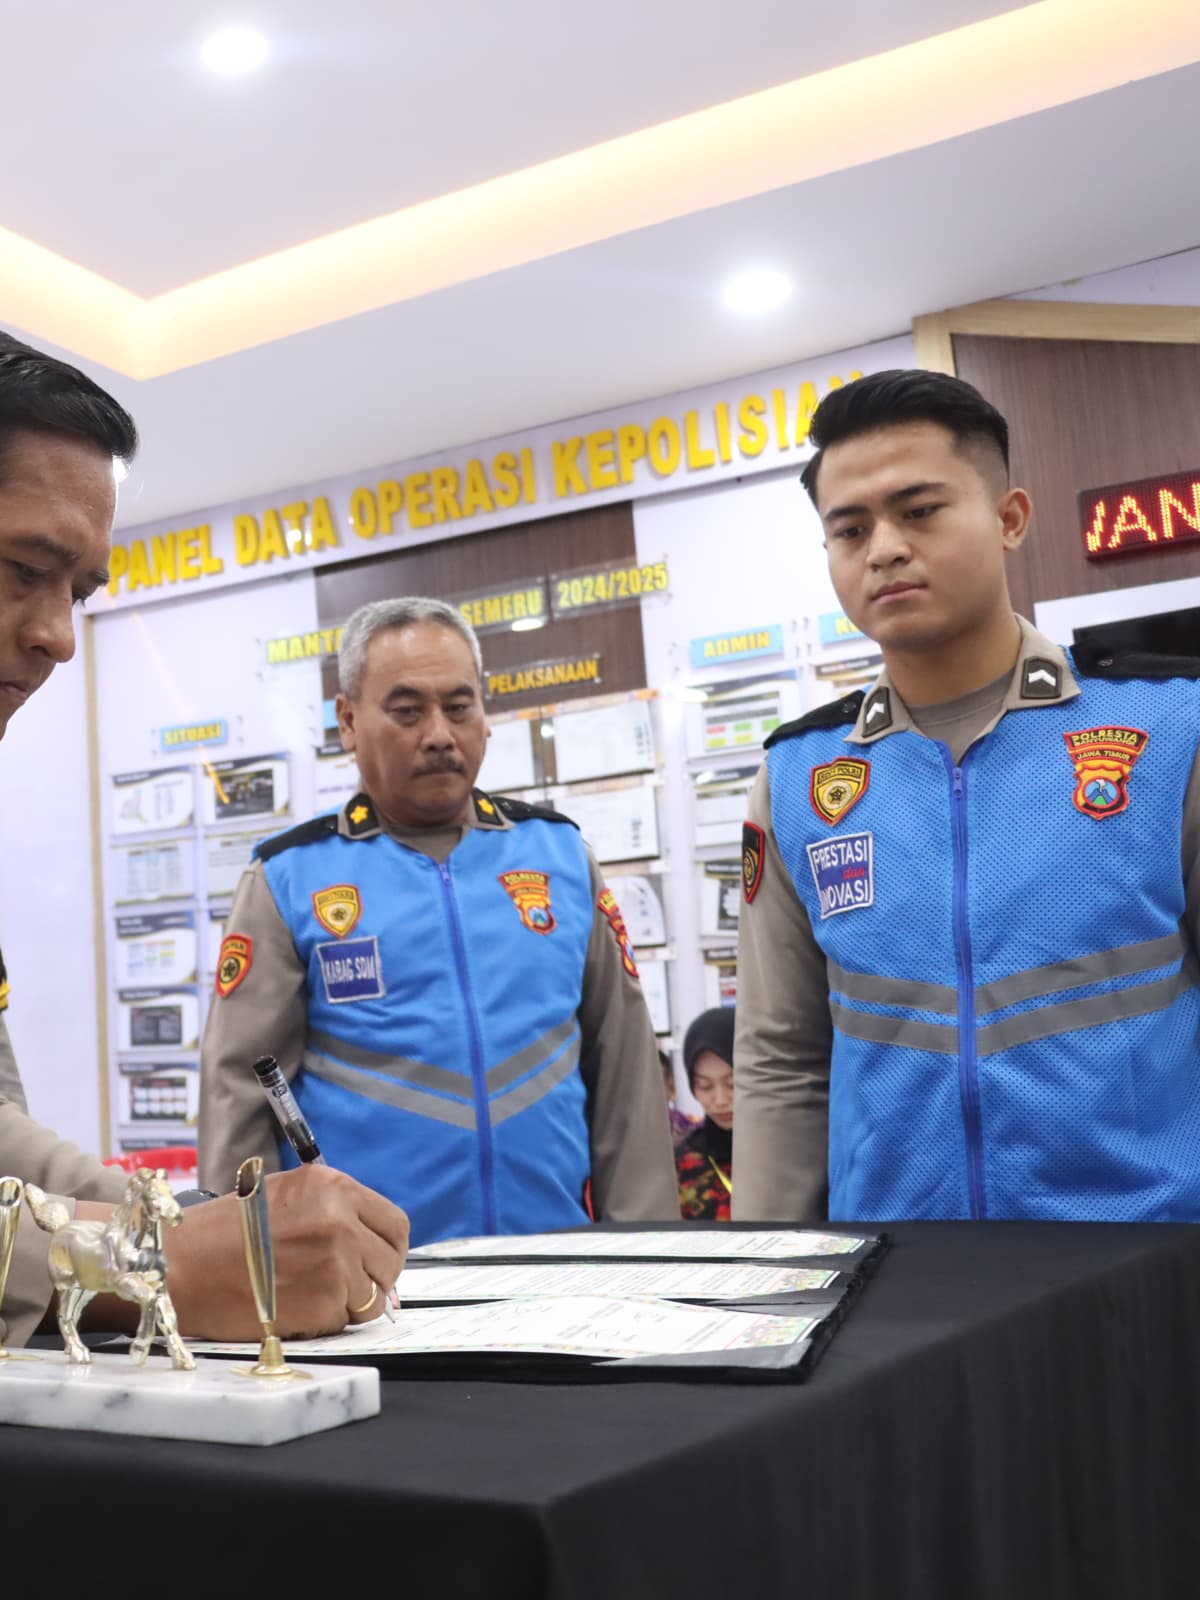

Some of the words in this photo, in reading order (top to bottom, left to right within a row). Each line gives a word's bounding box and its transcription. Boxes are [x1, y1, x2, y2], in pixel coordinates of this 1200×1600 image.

[108, 524, 224, 596] PANEL
[234, 496, 338, 567] DATA
[351, 447, 537, 540] OPERASI
[551, 370, 864, 497] KEPOLISIA
[459, 587, 545, 627] SEMERU
[557, 562, 669, 609] 2024/2025
[704, 631, 771, 659] ADMIN
[488, 658, 598, 694] PELAKSANAAN
[163, 721, 223, 747] SITUASI
[1071, 729, 1139, 744] POLRESTA
[1077, 750, 1102, 760] JAWA
[1103, 750, 1131, 761] TIMUR
[812, 839, 868, 874] PRESTASI
[354, 955, 377, 980] SDM
